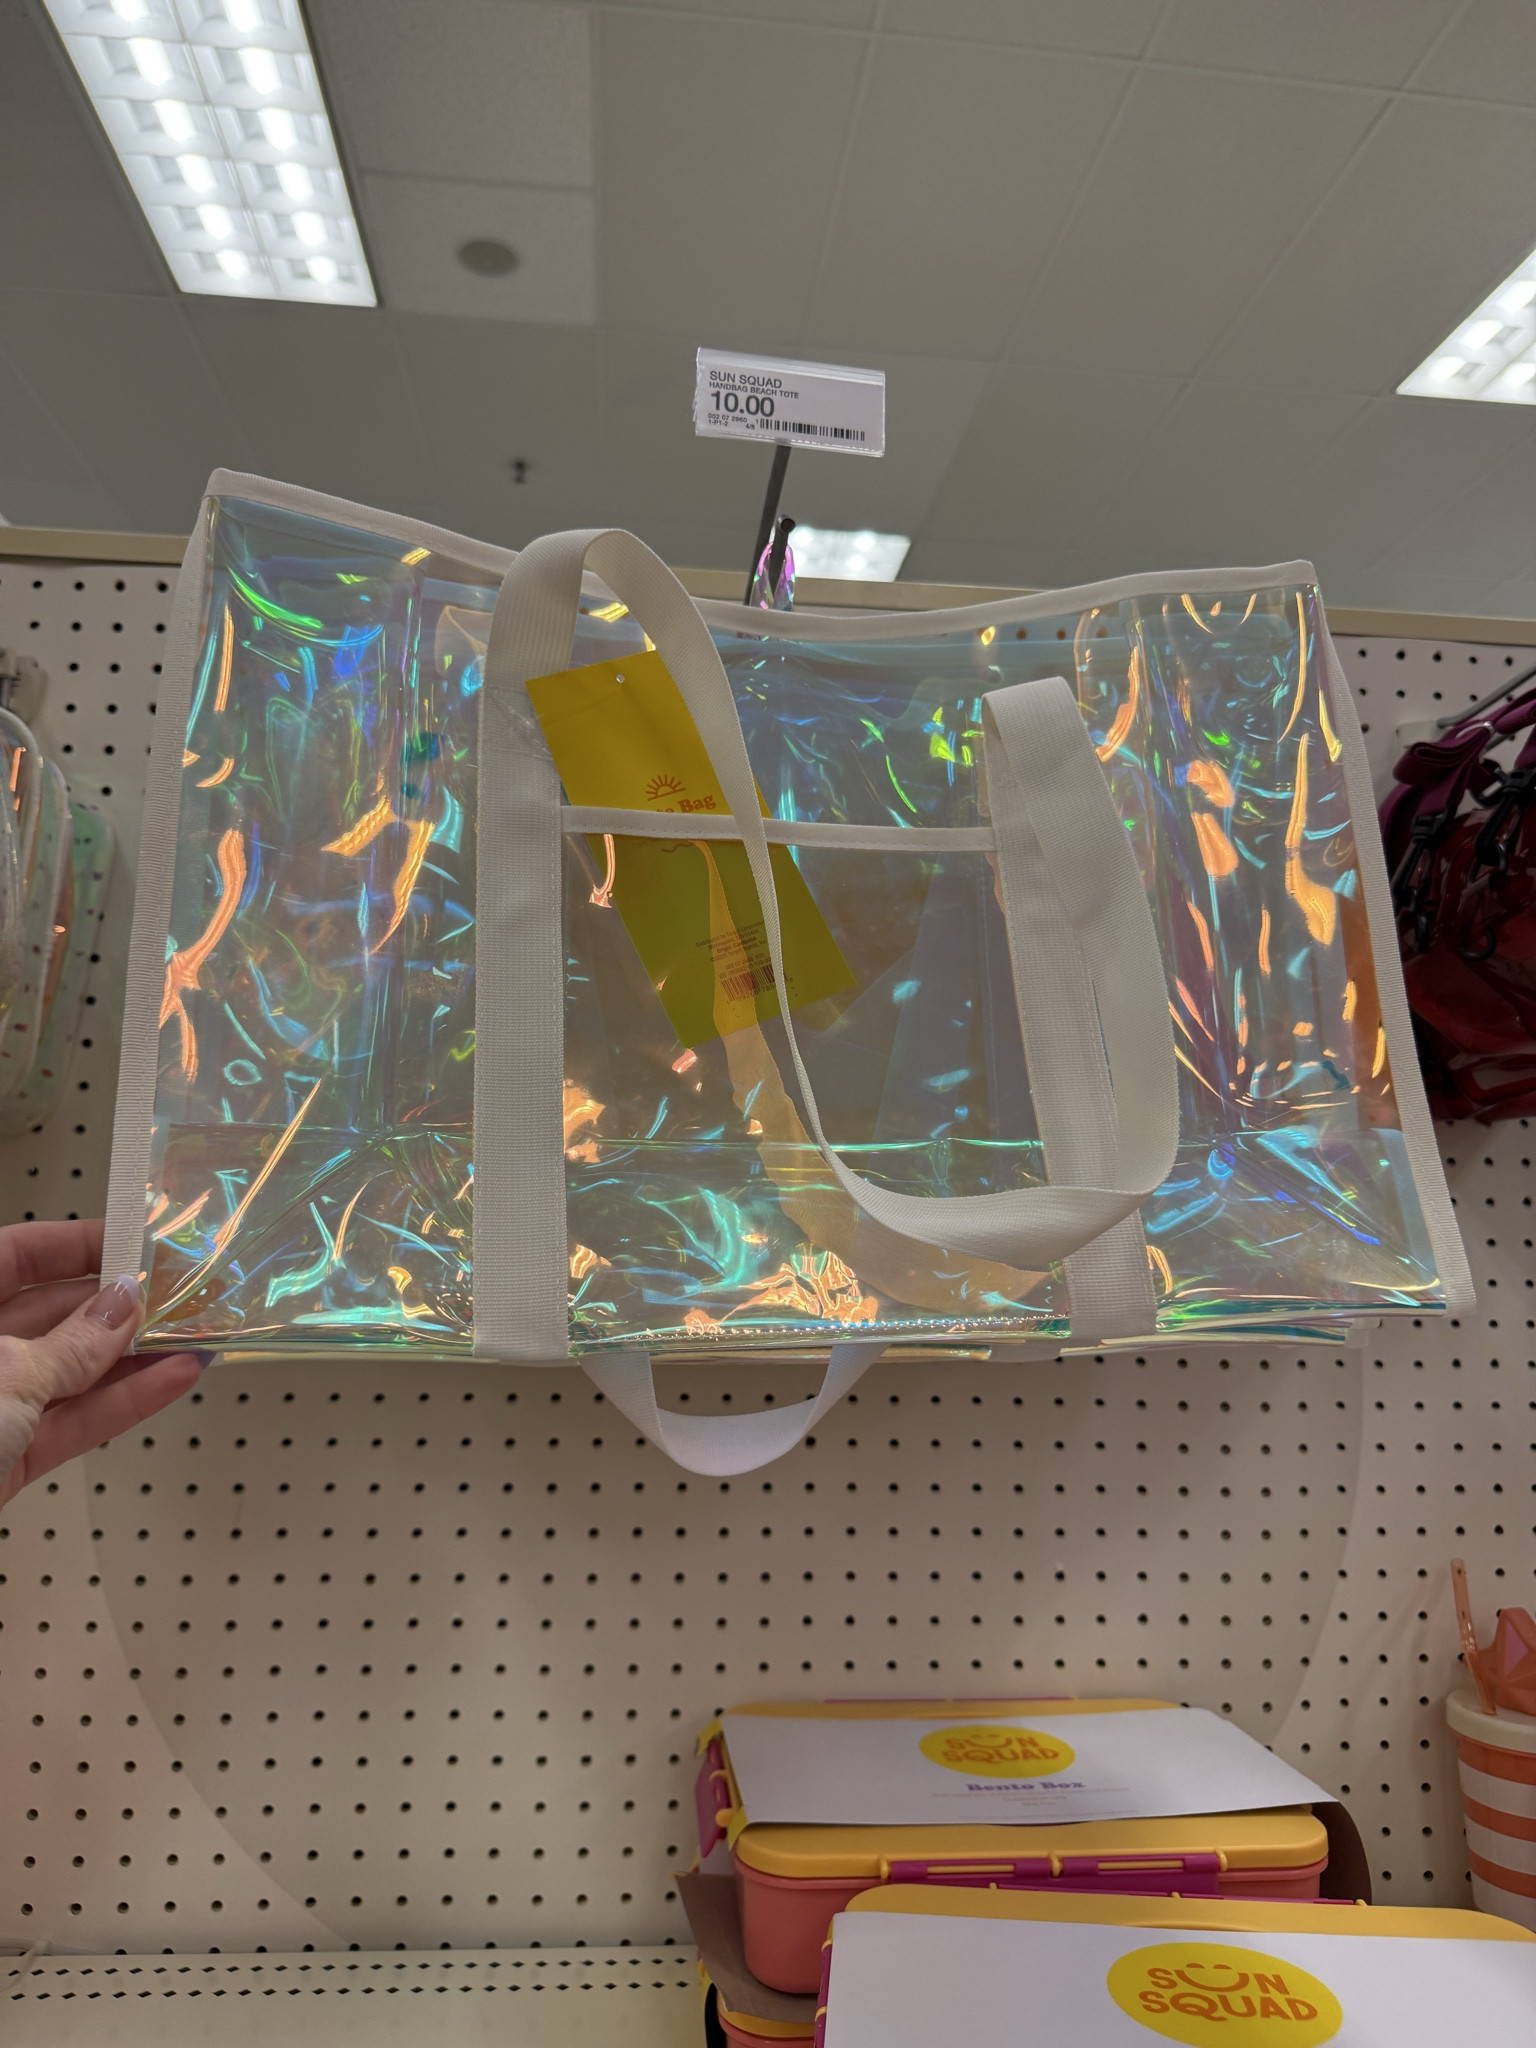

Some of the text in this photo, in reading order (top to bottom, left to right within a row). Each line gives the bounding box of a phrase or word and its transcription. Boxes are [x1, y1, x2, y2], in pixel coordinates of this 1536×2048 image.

[709, 370, 782, 389] SUN SQUAD
[709, 381, 800, 399] HANDBAG BEACH TOTE
[711, 390, 775, 418] 10.00
[677, 794, 717, 813] Bag
[945, 1735, 1041, 1751] SUN
[942, 1747, 1060, 1764] SQUAD
[965, 1781, 1035, 1792] Bento
[1040, 1780, 1086, 1790] Box
[1147, 1963, 1291, 1996] SUN
[1138, 1990, 1319, 2022] SQUAD
